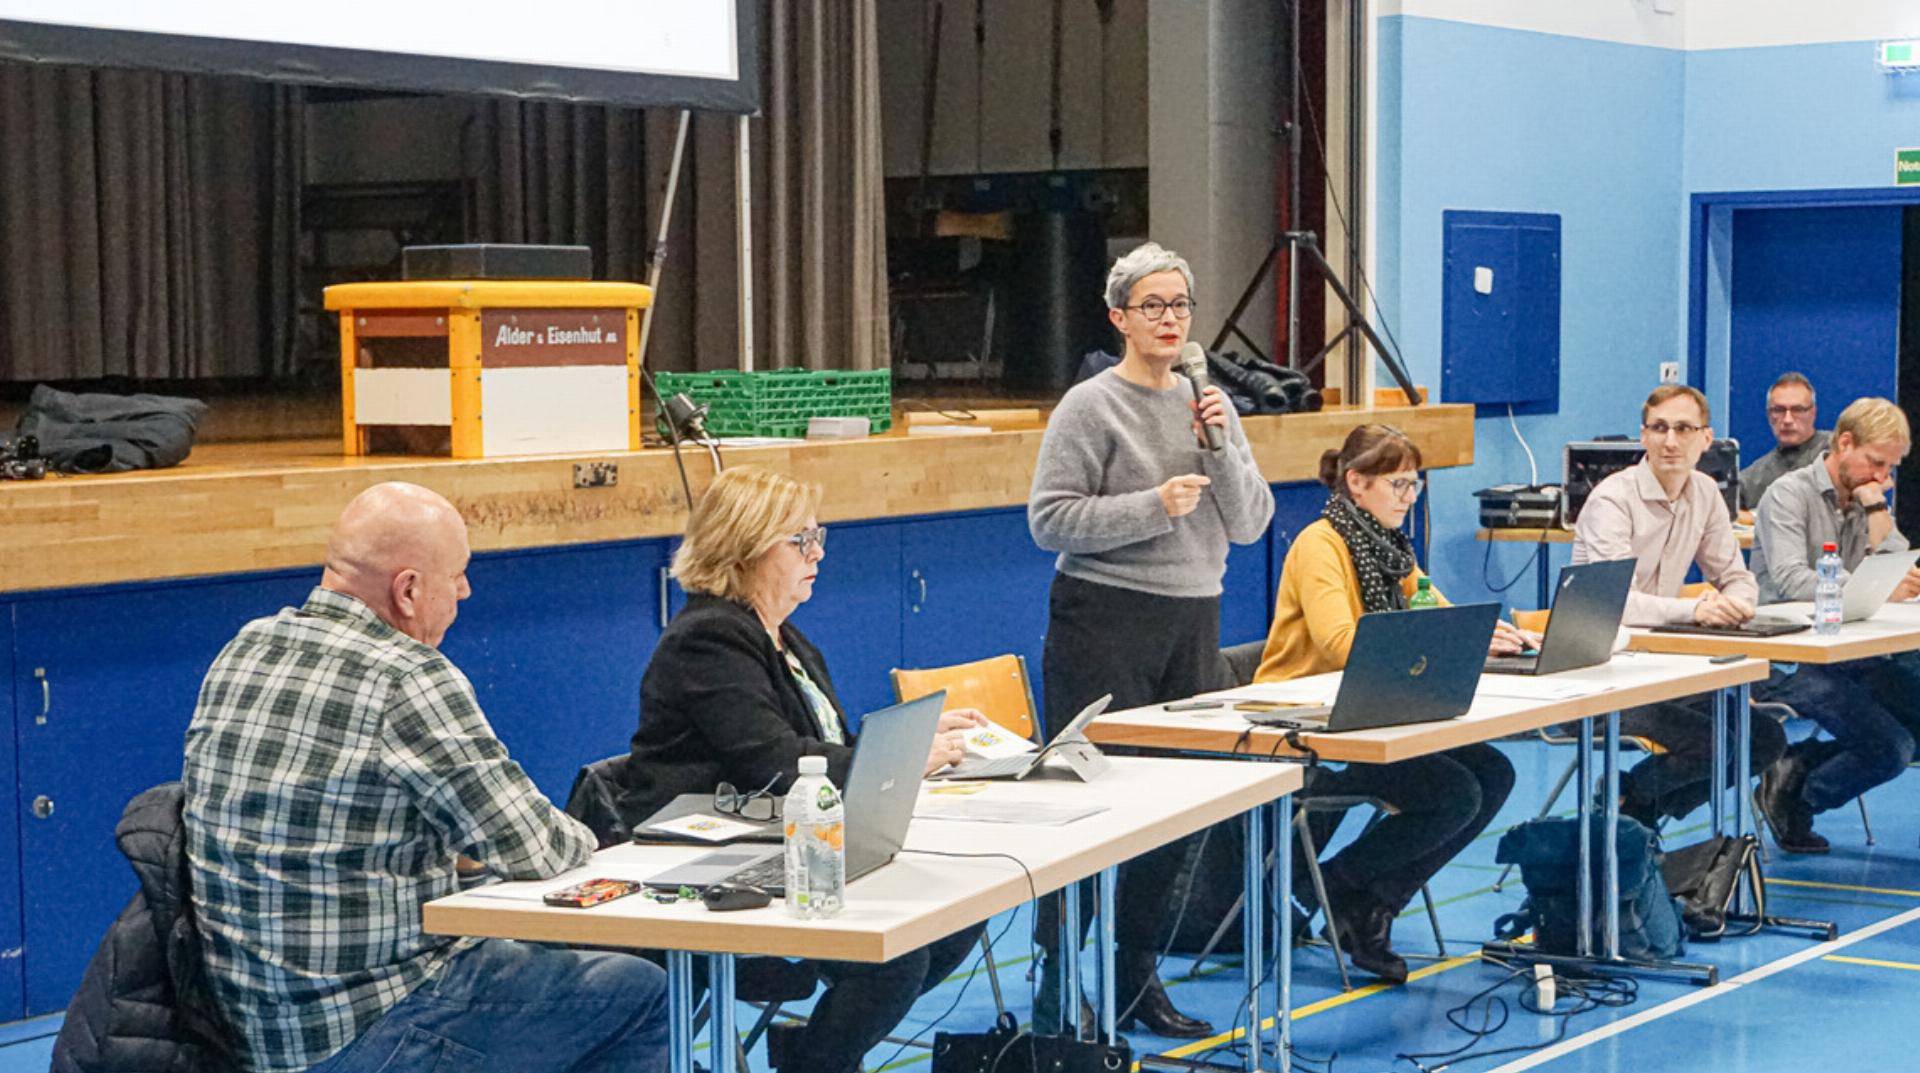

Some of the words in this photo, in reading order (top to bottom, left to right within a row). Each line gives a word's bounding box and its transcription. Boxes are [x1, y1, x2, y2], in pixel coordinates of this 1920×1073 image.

[1899, 160, 1920, 172] Not
[494, 324, 535, 347] Alder
[547, 325, 602, 344] Eisenhut
